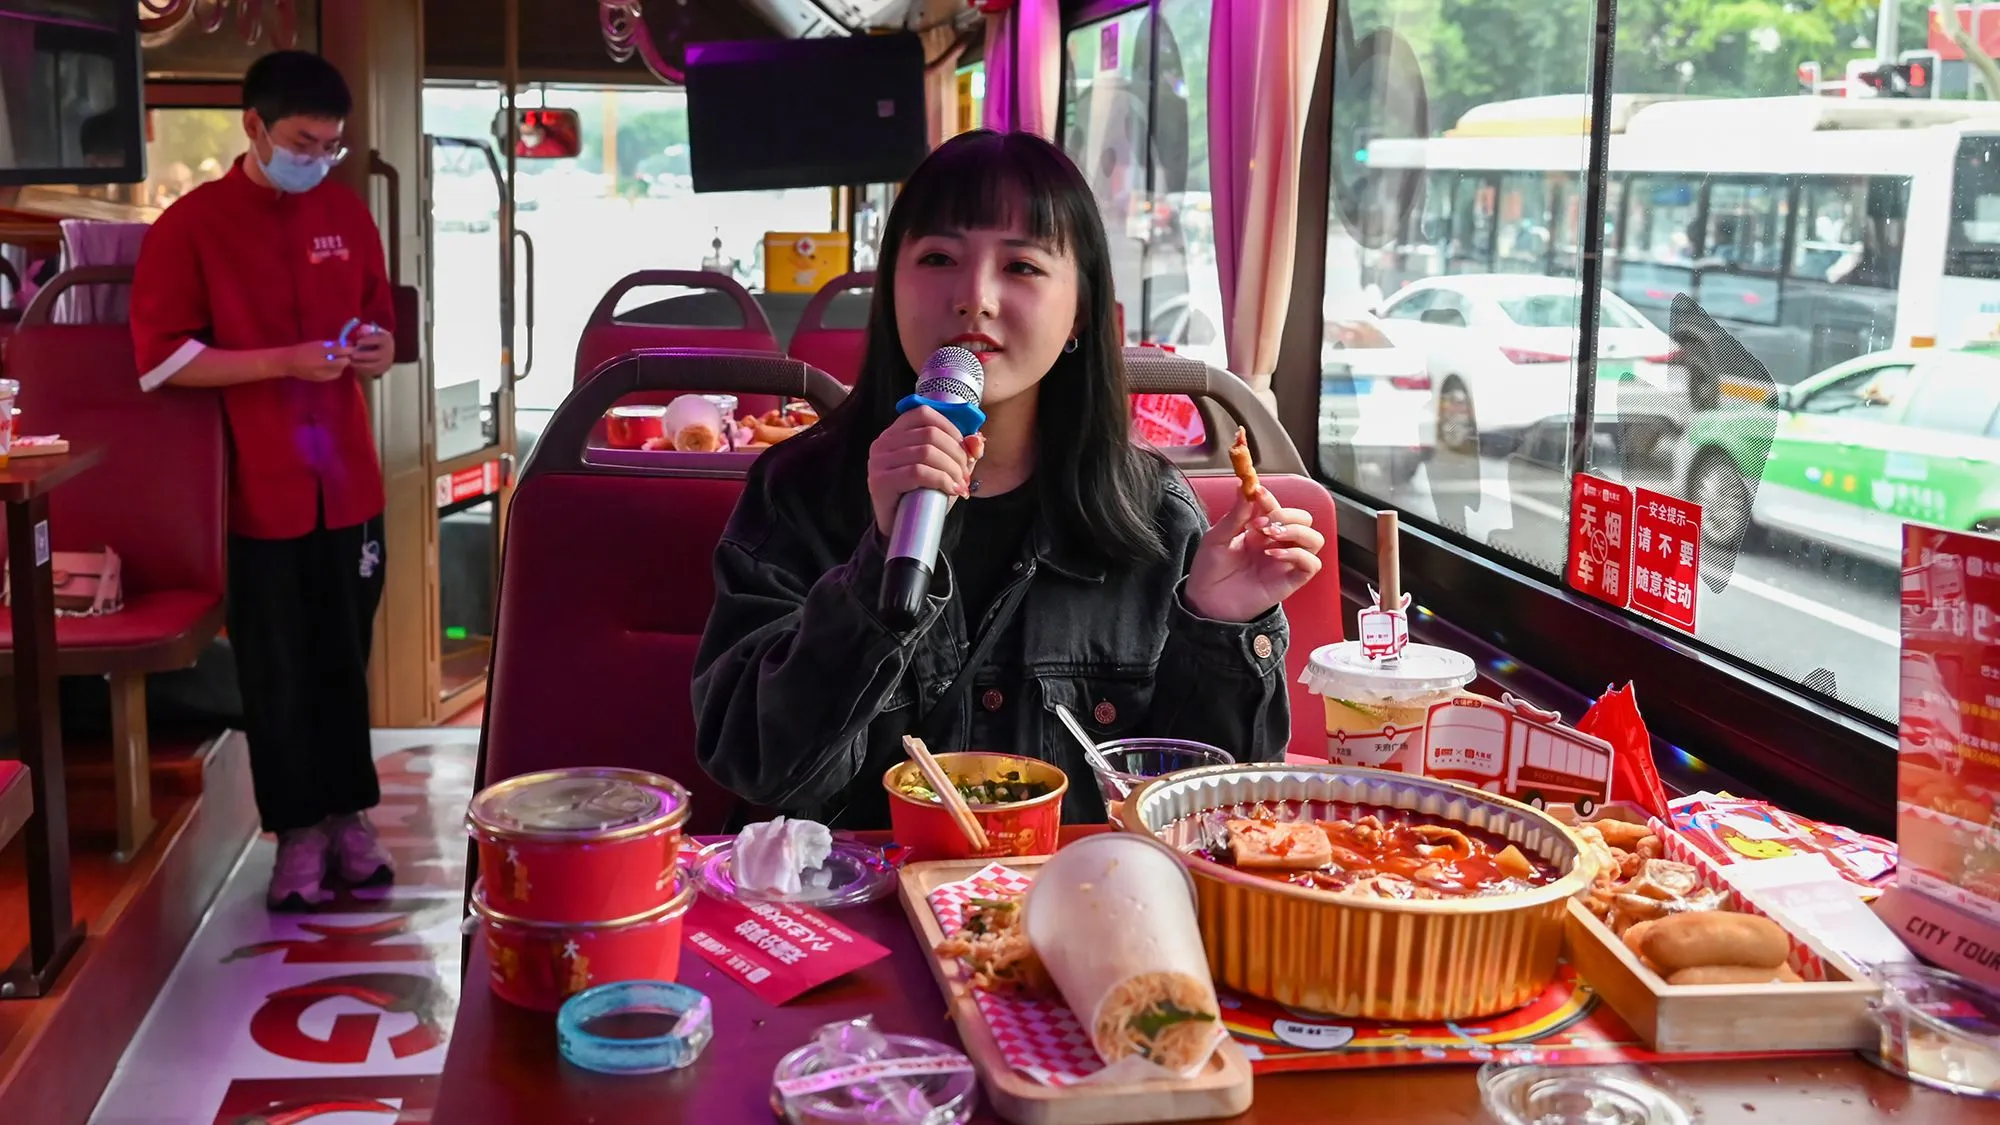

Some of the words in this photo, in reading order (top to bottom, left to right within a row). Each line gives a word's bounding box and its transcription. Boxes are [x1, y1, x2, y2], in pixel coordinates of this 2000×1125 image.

[1580, 503, 1622, 549] 无烟
[1649, 501, 1686, 526] 安全提示
[1637, 525, 1694, 568] 请不要
[1577, 550, 1620, 597] 车厢
[1636, 565, 1692, 609] 随意走动
[1905, 916, 1951, 945] CITY
[1953, 935, 2000, 972] TOUR
